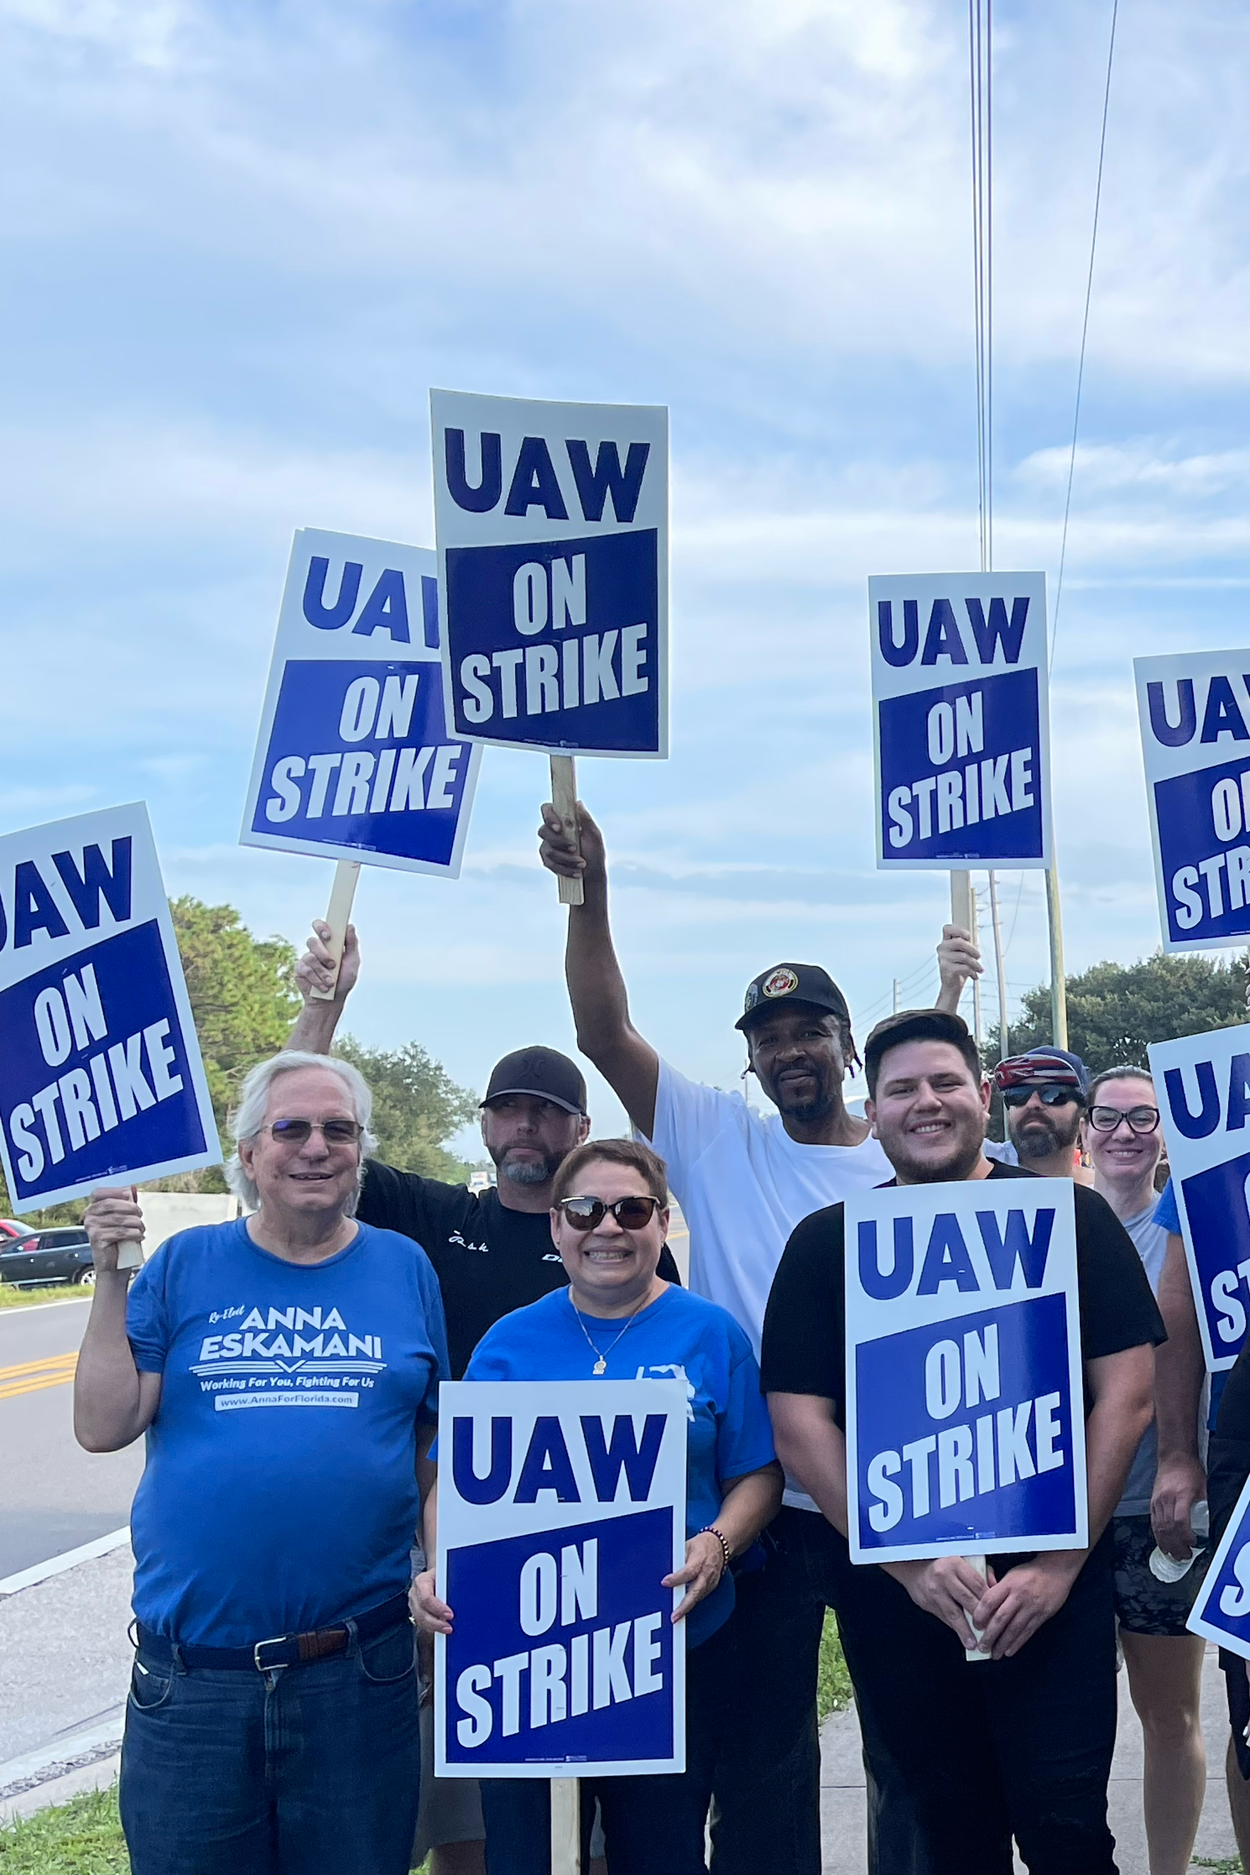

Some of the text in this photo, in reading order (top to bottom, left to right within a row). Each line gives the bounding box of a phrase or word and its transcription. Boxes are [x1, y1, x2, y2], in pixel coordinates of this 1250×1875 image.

[444, 427, 651, 523] UAW
[302, 556, 439, 649] UA
[513, 552, 586, 635] ON
[877, 597, 1031, 668] UAW
[339, 673, 418, 743] ON
[460, 622, 650, 724] STRIKE
[926, 690, 984, 766] ON
[265, 744, 462, 823] STRIKE
[887, 747, 1034, 848] STRIKE
[0, 836, 132, 950] AW
[33, 962, 108, 1067] ON
[9, 1017, 184, 1183] STRIKE
[857, 1208, 1056, 1300] UAW
[199, 1332, 382, 1361] ESKAMANI
[239, 1306, 347, 1330] ANNA
[200, 1376, 375, 1392] Working For You, Fighting For Us
[220, 1394, 353, 1407] www.AnnaForFlorida.com
[924, 1322, 1000, 1421] ON
[451, 1413, 668, 1505] UAW
[866, 1390, 1064, 1533] STRIKE
[519, 1537, 599, 1637] ON
[455, 1611, 663, 1749] STRIKE
